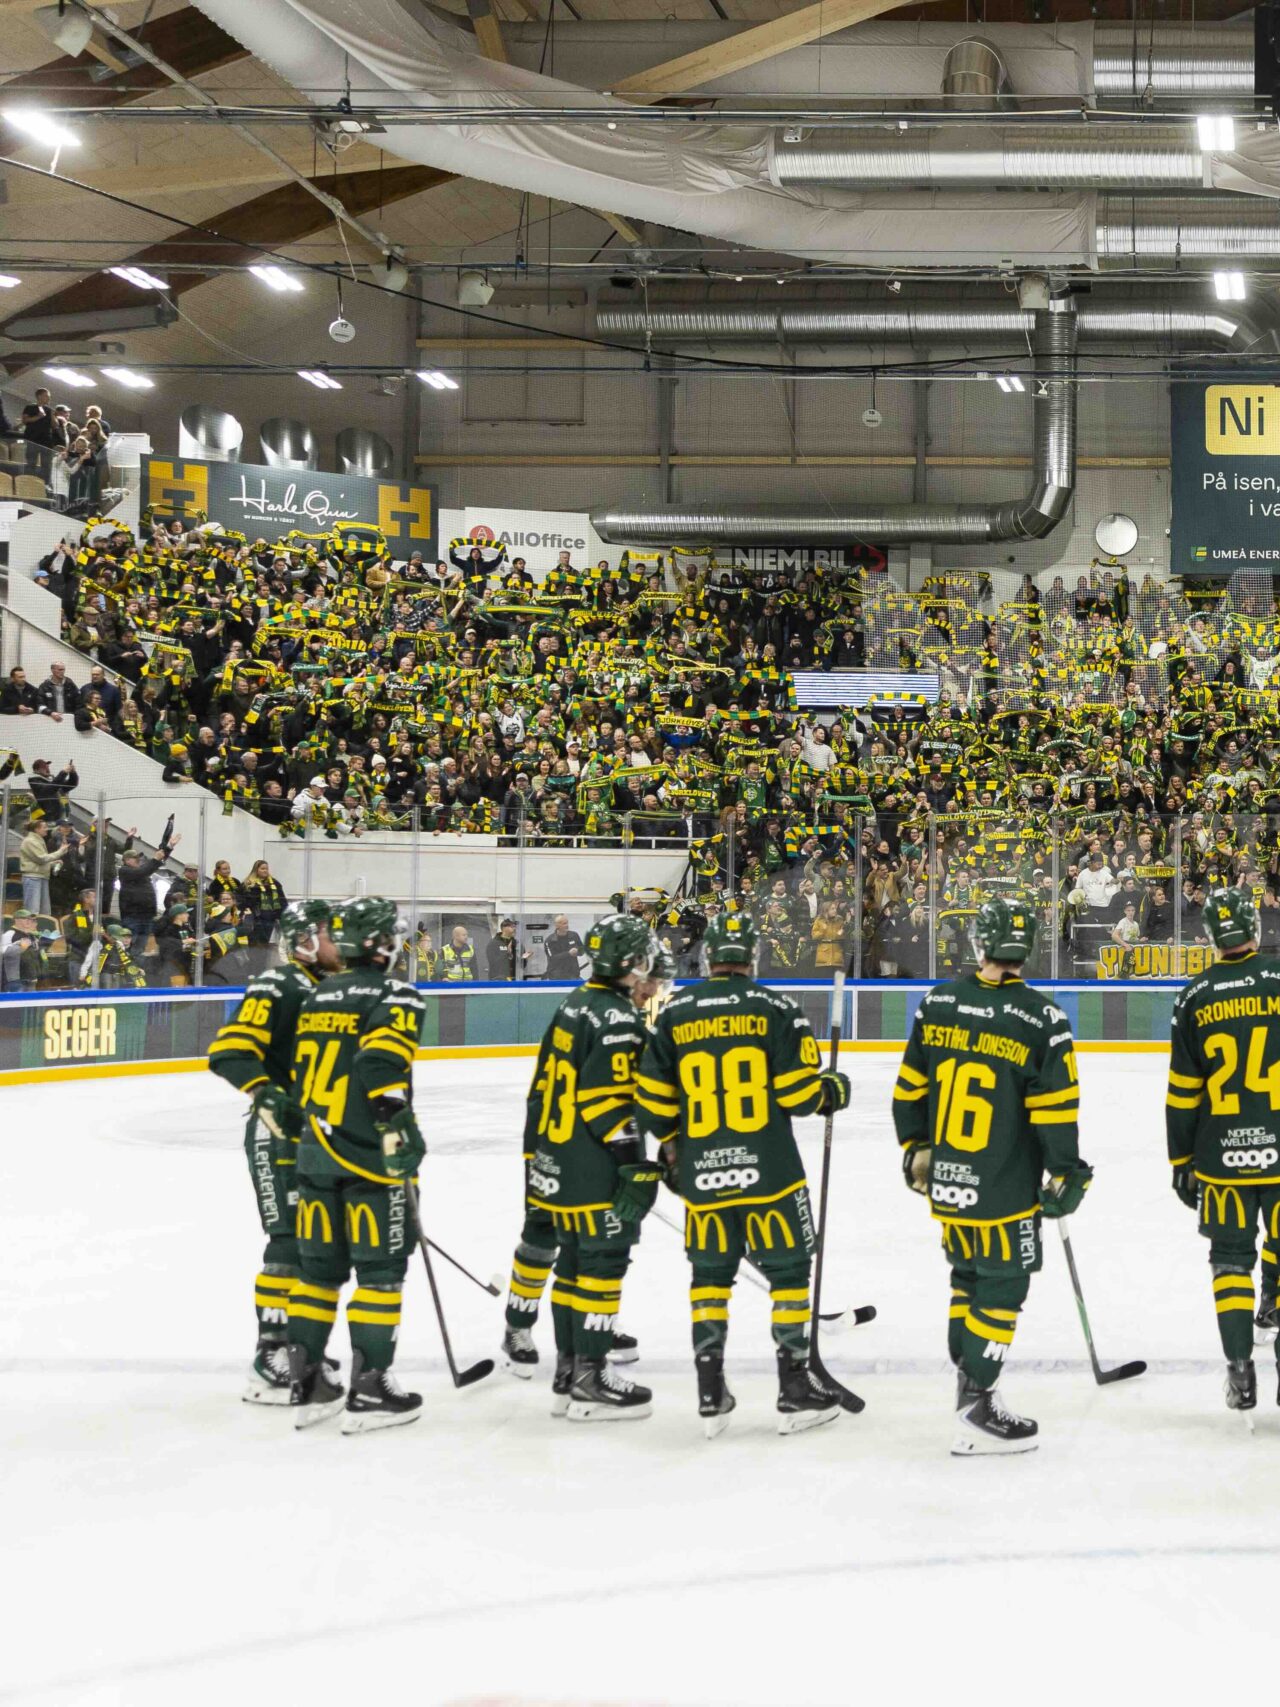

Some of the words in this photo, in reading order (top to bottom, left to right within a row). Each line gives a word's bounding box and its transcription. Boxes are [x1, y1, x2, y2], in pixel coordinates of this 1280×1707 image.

[1219, 396, 1264, 436] Ni
[1203, 473, 1227, 490] På
[1234, 474, 1280, 493] isen,
[1249, 499, 1254, 517] i
[499, 530, 586, 550] AllOffice
[735, 549, 809, 571] NIEMI
[1212, 548, 1247, 559] UMEÅ
[238, 998, 272, 1026] 86
[45, 1008, 117, 1059] SEGER
[973, 1033, 1030, 1067] JONSSON
[679, 1046, 769, 1138] 88
[935, 1058, 997, 1152] 16
[1221, 1133, 1277, 1146] WELLNESS
[1227, 1126, 1266, 1138] NORDIC
[694, 1154, 758, 1171] WELLNESS
[704, 1147, 748, 1160] NORDIC
[1222, 1147, 1279, 1169] coop
[255, 1139, 281, 1227] Lerstenen.
[695, 1167, 760, 1191] coop
